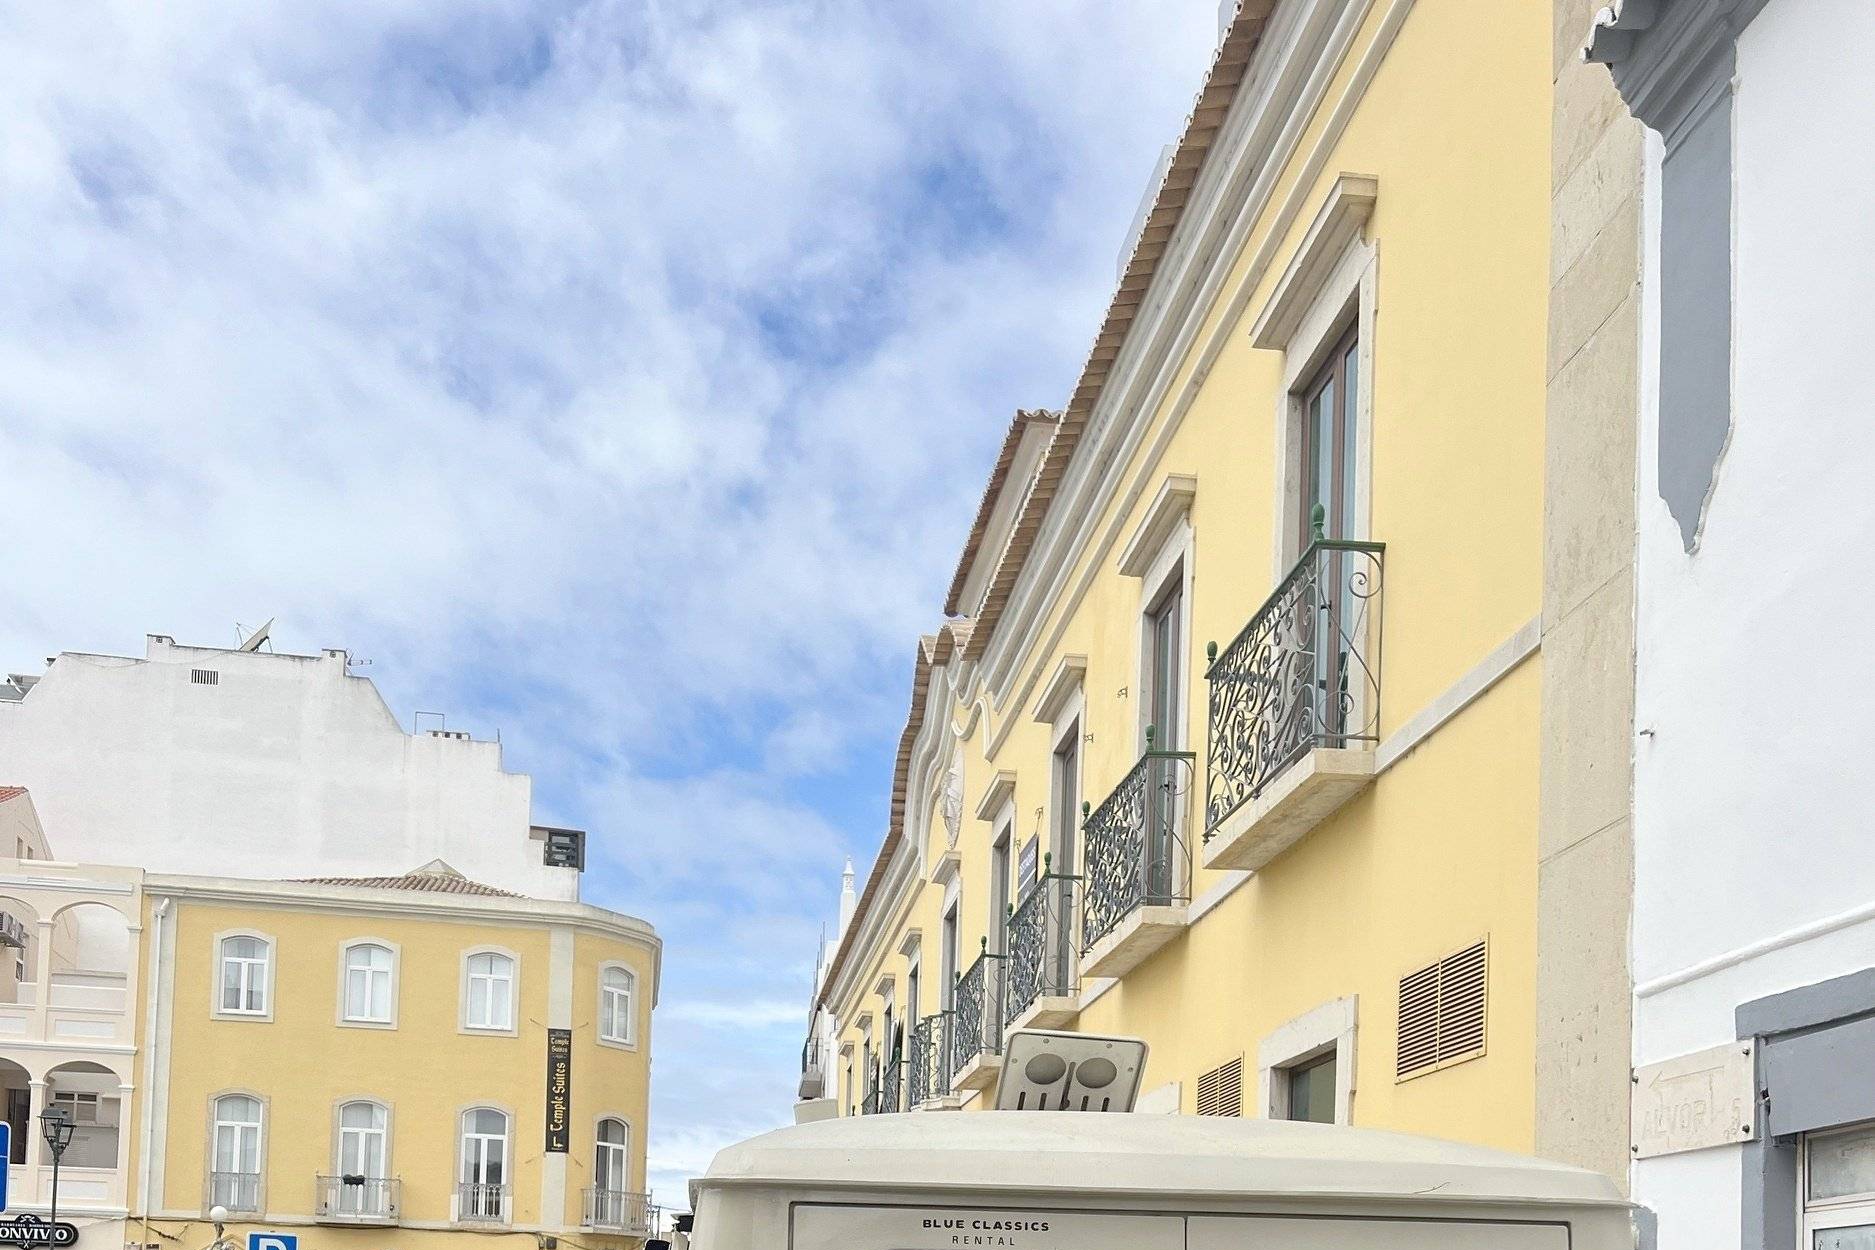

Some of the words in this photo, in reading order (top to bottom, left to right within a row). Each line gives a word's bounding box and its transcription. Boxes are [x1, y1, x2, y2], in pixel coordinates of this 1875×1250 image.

[552, 1062, 566, 1094] Suites
[550, 1095, 566, 1131] Temple
[922, 1219, 965, 1229] BLUE
[972, 1220, 1049, 1231] CLASSICS
[0, 1226, 67, 1241] ONVIVO
[951, 1235, 1015, 1246] RENTAL
